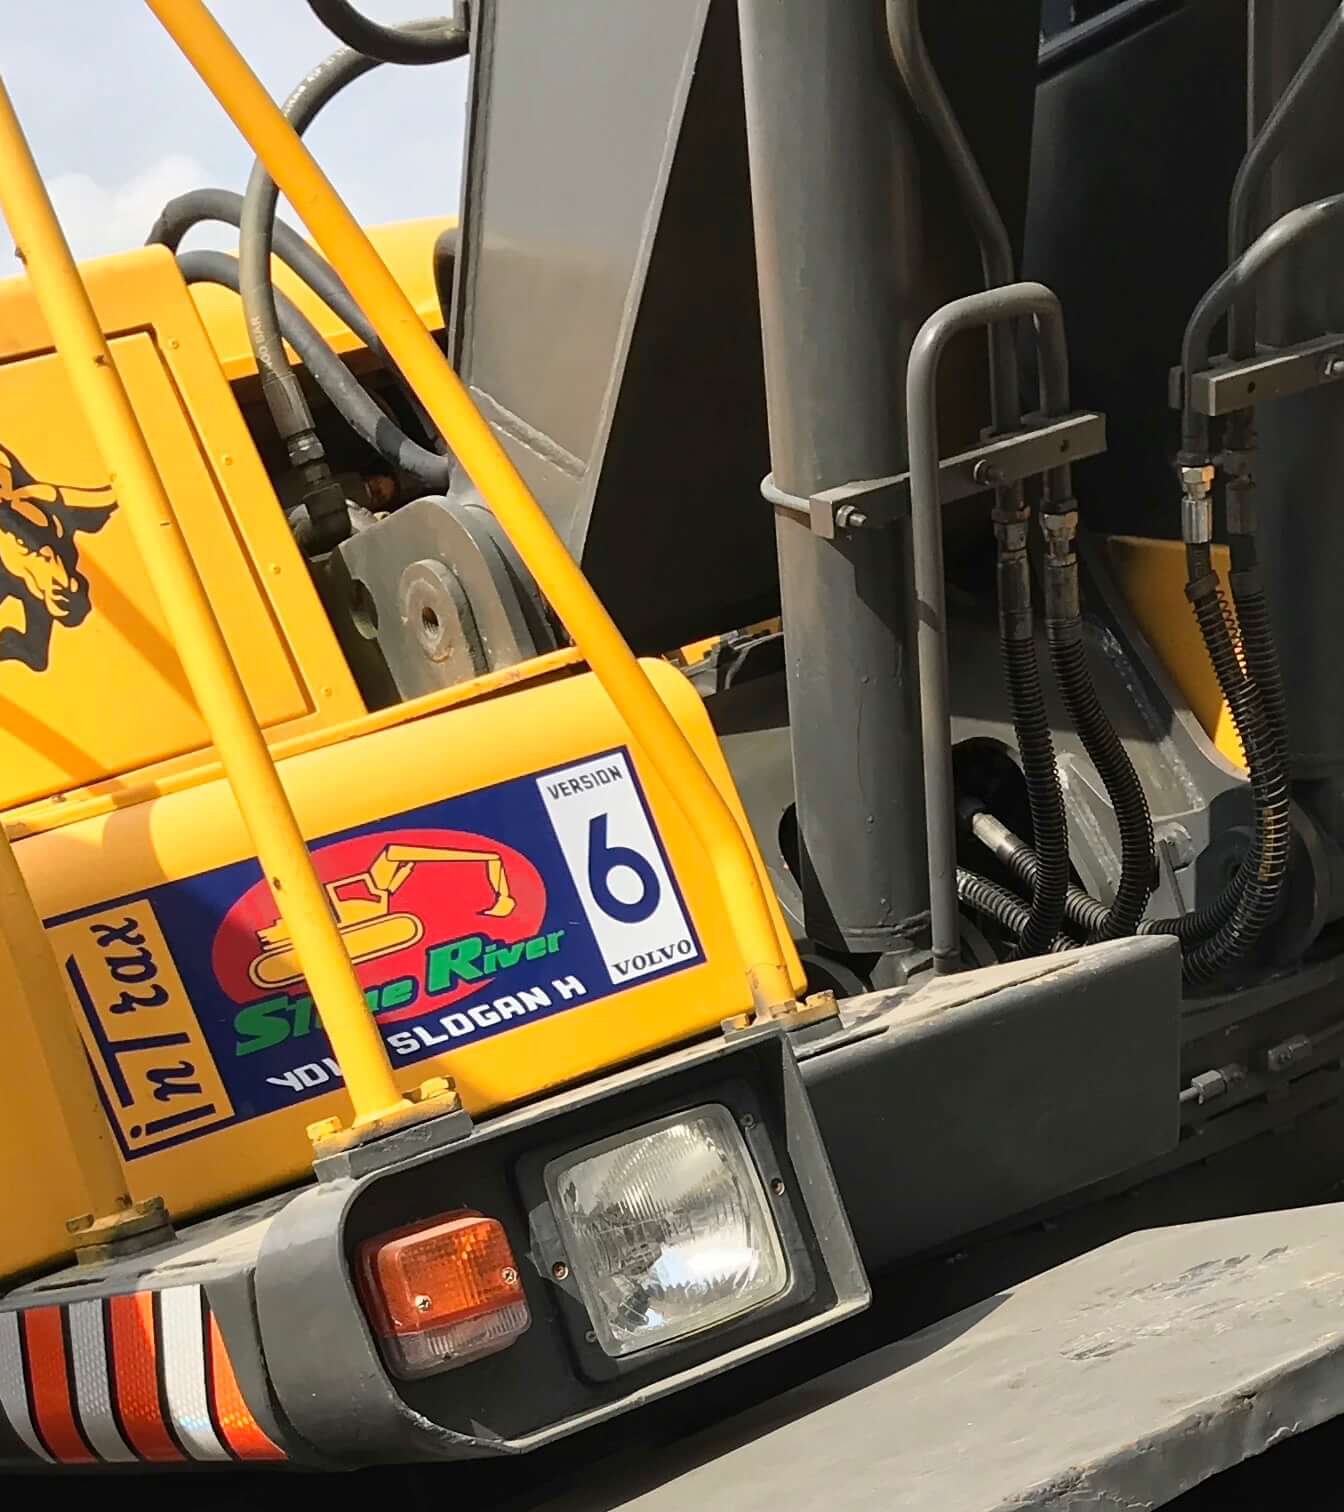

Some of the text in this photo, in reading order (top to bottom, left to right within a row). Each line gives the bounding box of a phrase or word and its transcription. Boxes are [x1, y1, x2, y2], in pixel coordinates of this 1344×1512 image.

[547, 766, 622, 800] VERSION
[588, 813, 661, 924] 6
[427, 928, 565, 993] River
[612, 939, 692, 977] VOLVO
[386, 986, 552, 1056] SLOGAN
